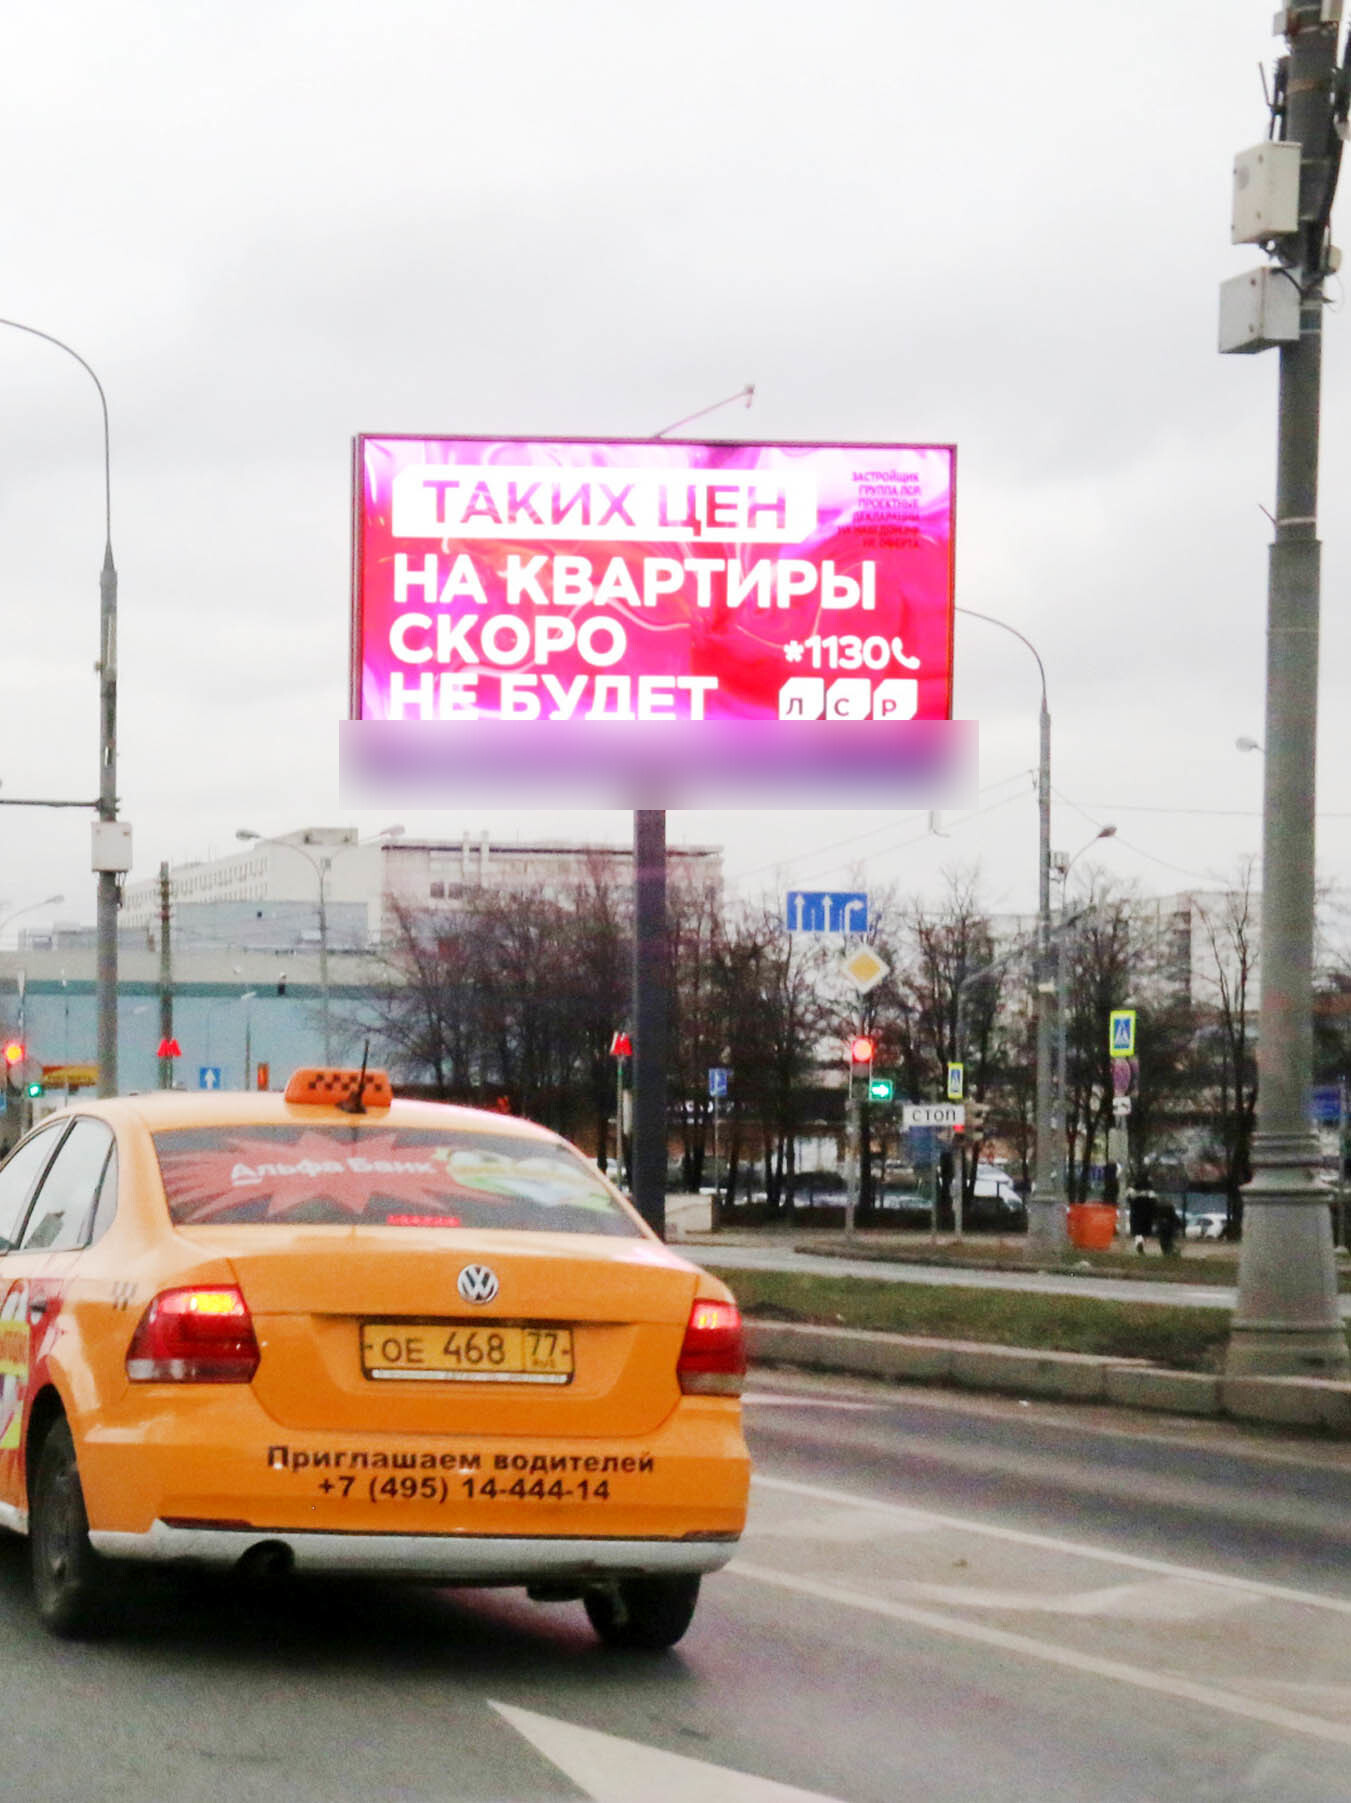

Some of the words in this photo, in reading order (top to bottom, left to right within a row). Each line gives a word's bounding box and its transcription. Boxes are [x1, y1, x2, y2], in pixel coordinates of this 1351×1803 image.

[423, 480, 636, 526] ТАКИХ
[658, 484, 786, 537] ЦЕН
[394, 553, 488, 604] НА
[506, 554, 876, 611] КВАРТИРЫ
[389, 612, 627, 667] СКОРО
[389, 672, 479, 720] НЕ
[500, 673, 718, 720] БУДЕТ
[912, 1109, 956, 1121] СТОП
[443, 1331, 506, 1365] 468
[527, 1331, 558, 1357] 77
[267, 1446, 481, 1473] Приглашаем
[494, 1452, 655, 1473] водителей
[319, 1476, 356, 1498] +7
[369, 1476, 449, 1503] (495)
[462, 1477, 611, 1501] 14-444-14
